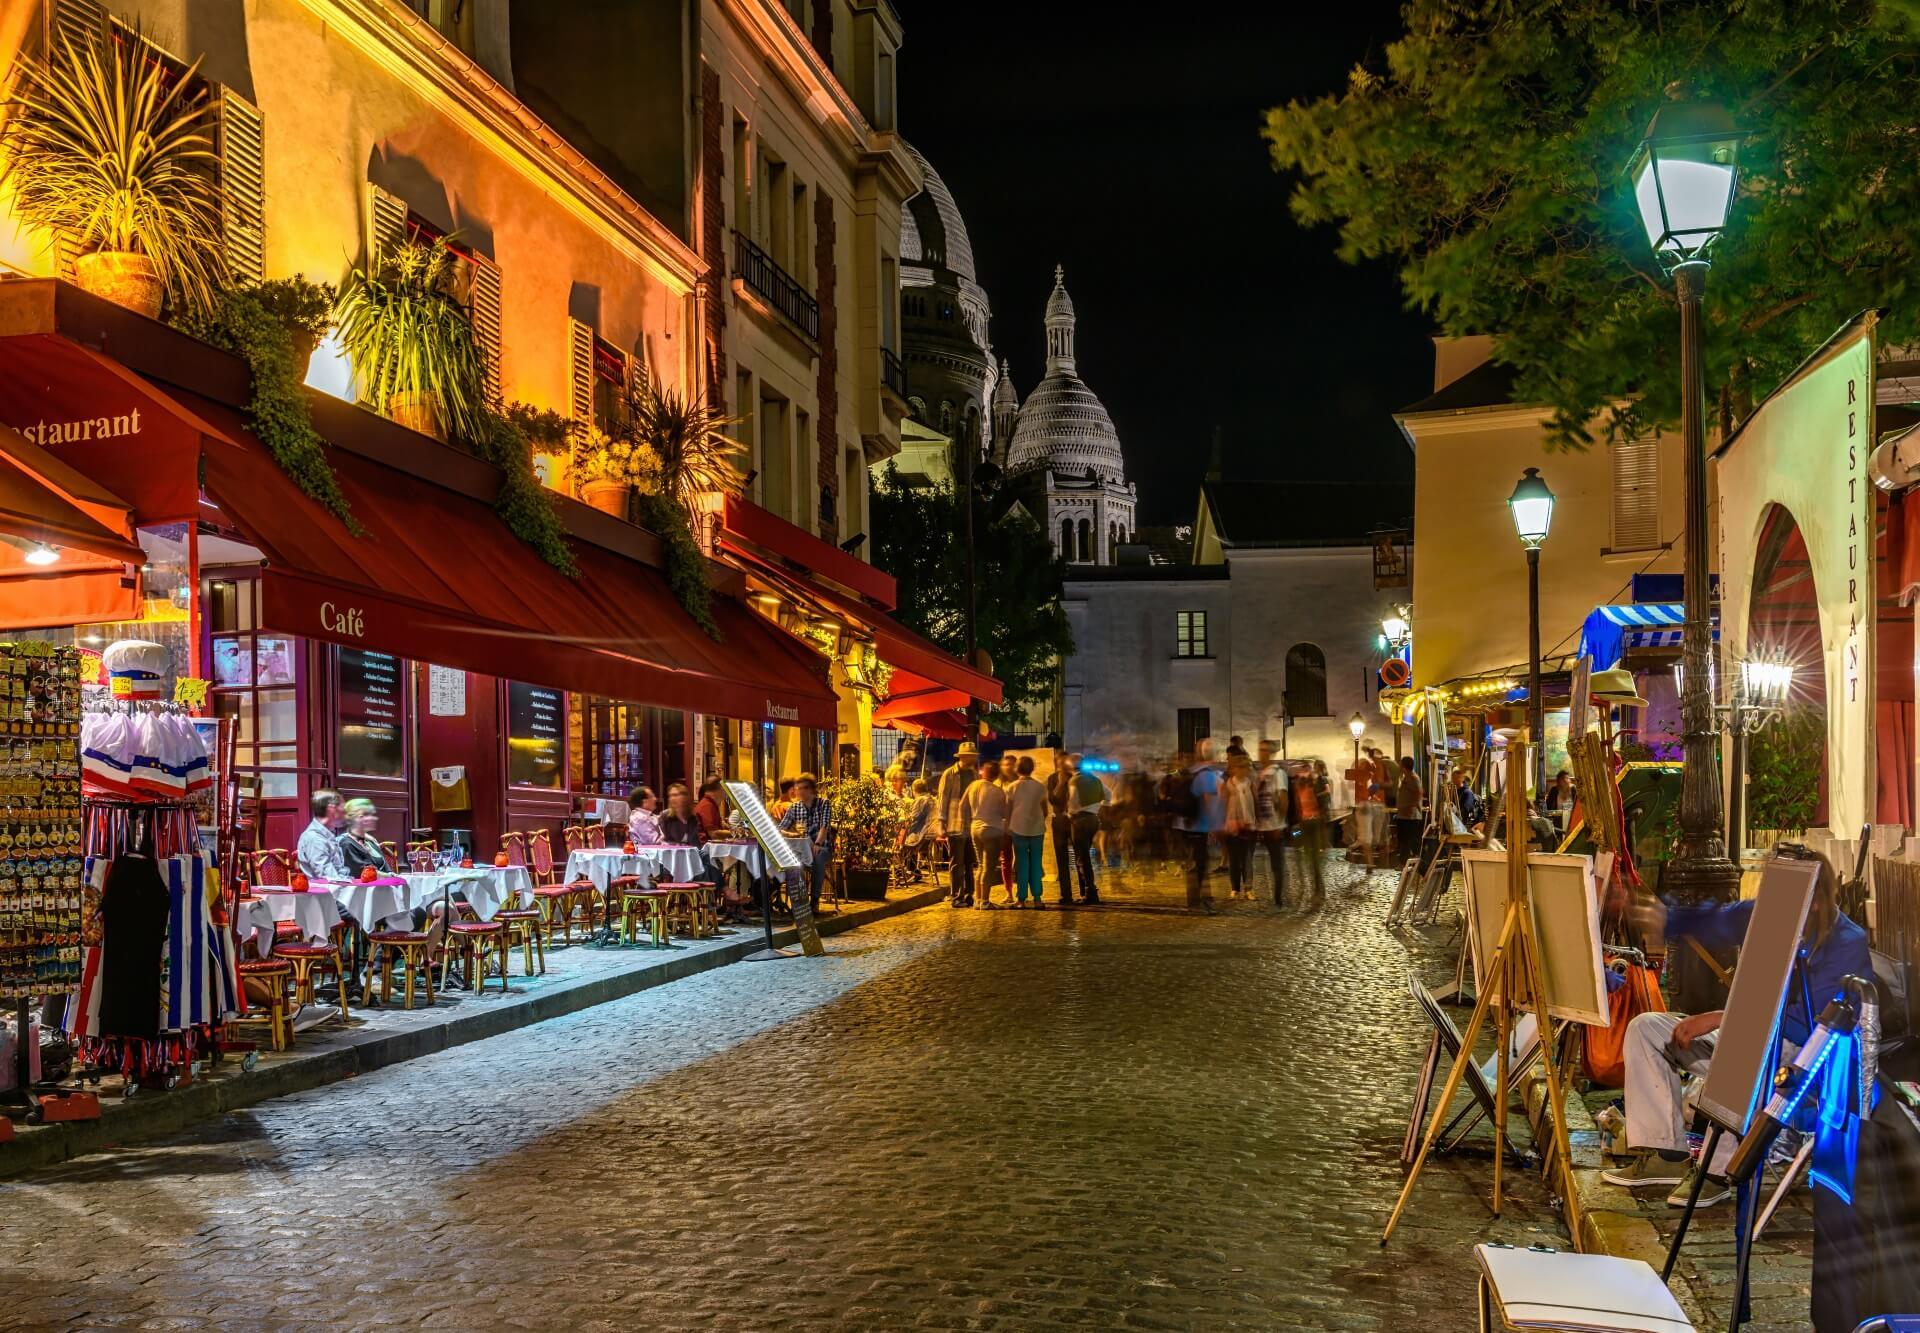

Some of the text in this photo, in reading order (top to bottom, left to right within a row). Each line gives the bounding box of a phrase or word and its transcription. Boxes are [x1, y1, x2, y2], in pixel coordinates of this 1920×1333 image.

[12, 407, 142, 446] staurant
[1847, 379, 1858, 702] RESTAURANT
[320, 601, 364, 637] Café
[766, 699, 799, 721] Restaurant
